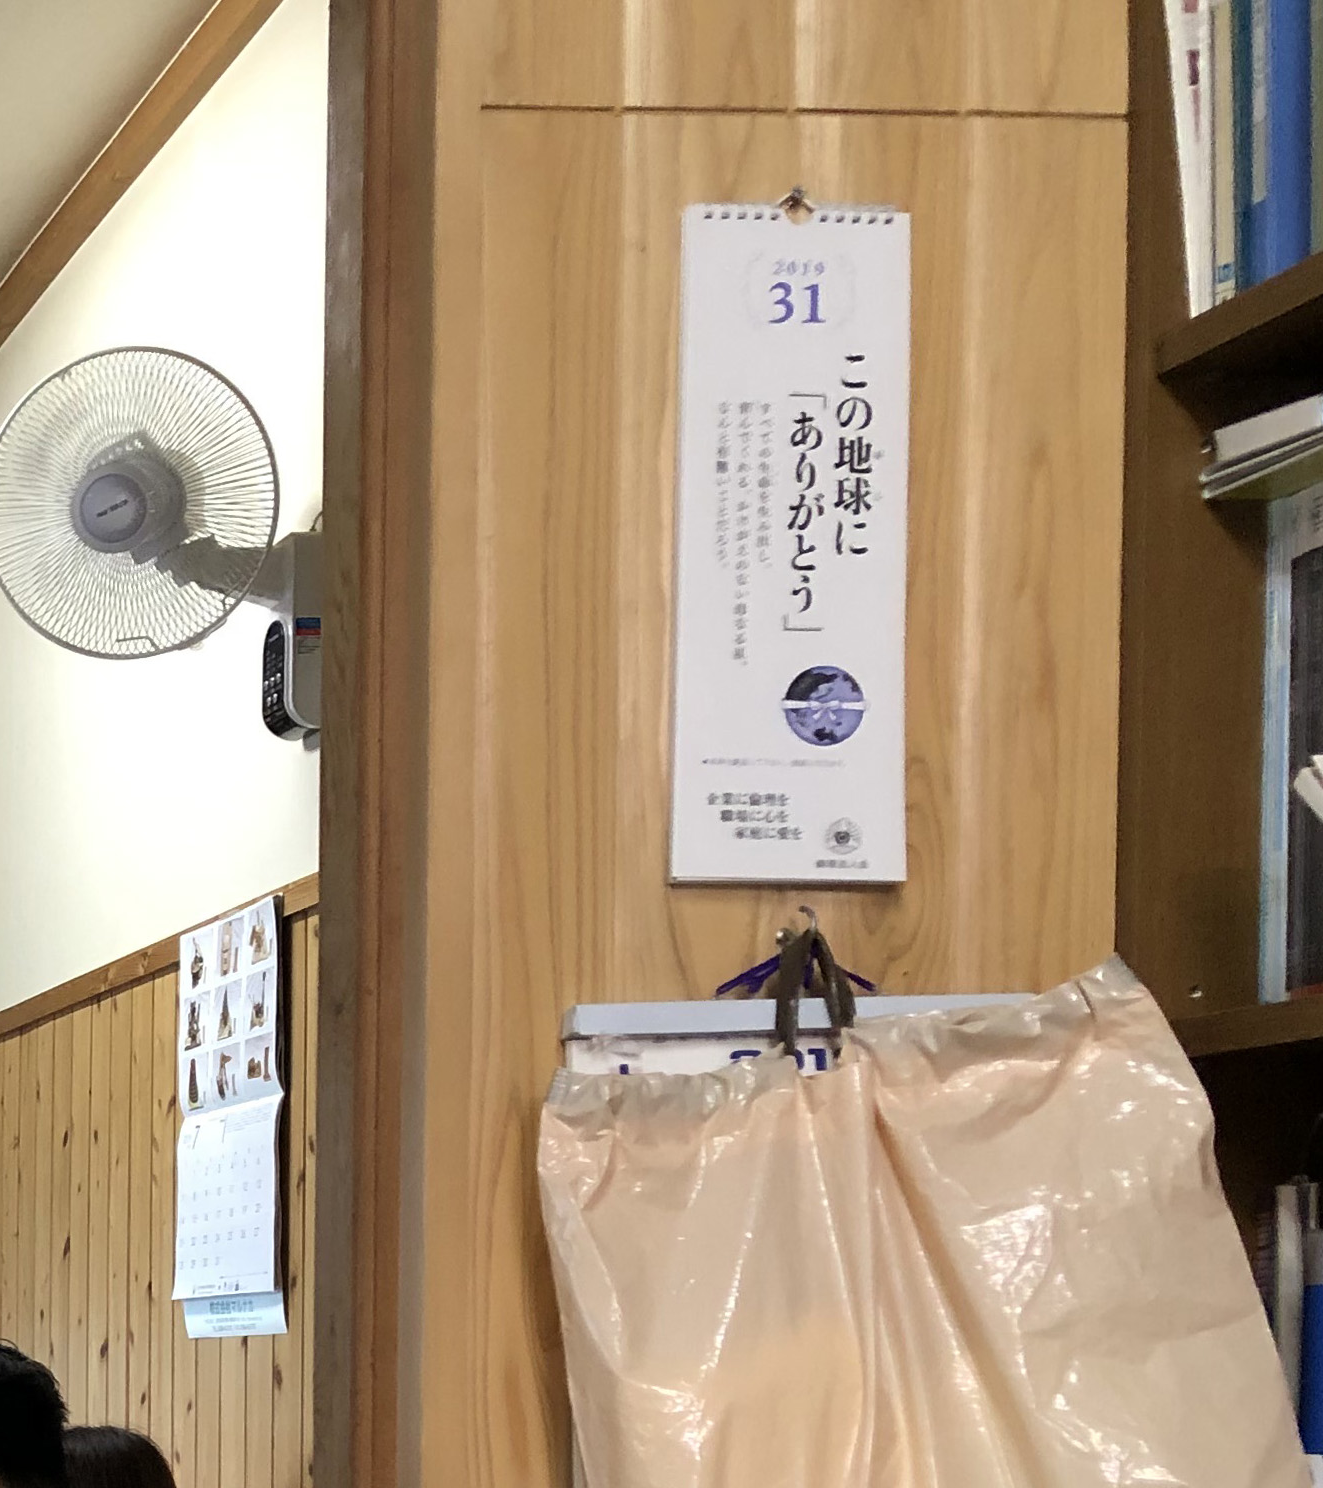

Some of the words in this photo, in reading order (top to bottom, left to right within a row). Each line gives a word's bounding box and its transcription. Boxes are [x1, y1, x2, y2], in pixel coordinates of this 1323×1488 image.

[767, 281, 826, 324] 31
[772, 259, 825, 276] 2019
[781, 393, 828, 632] 「ありがとう」
[833, 353, 875, 557] この地球に
